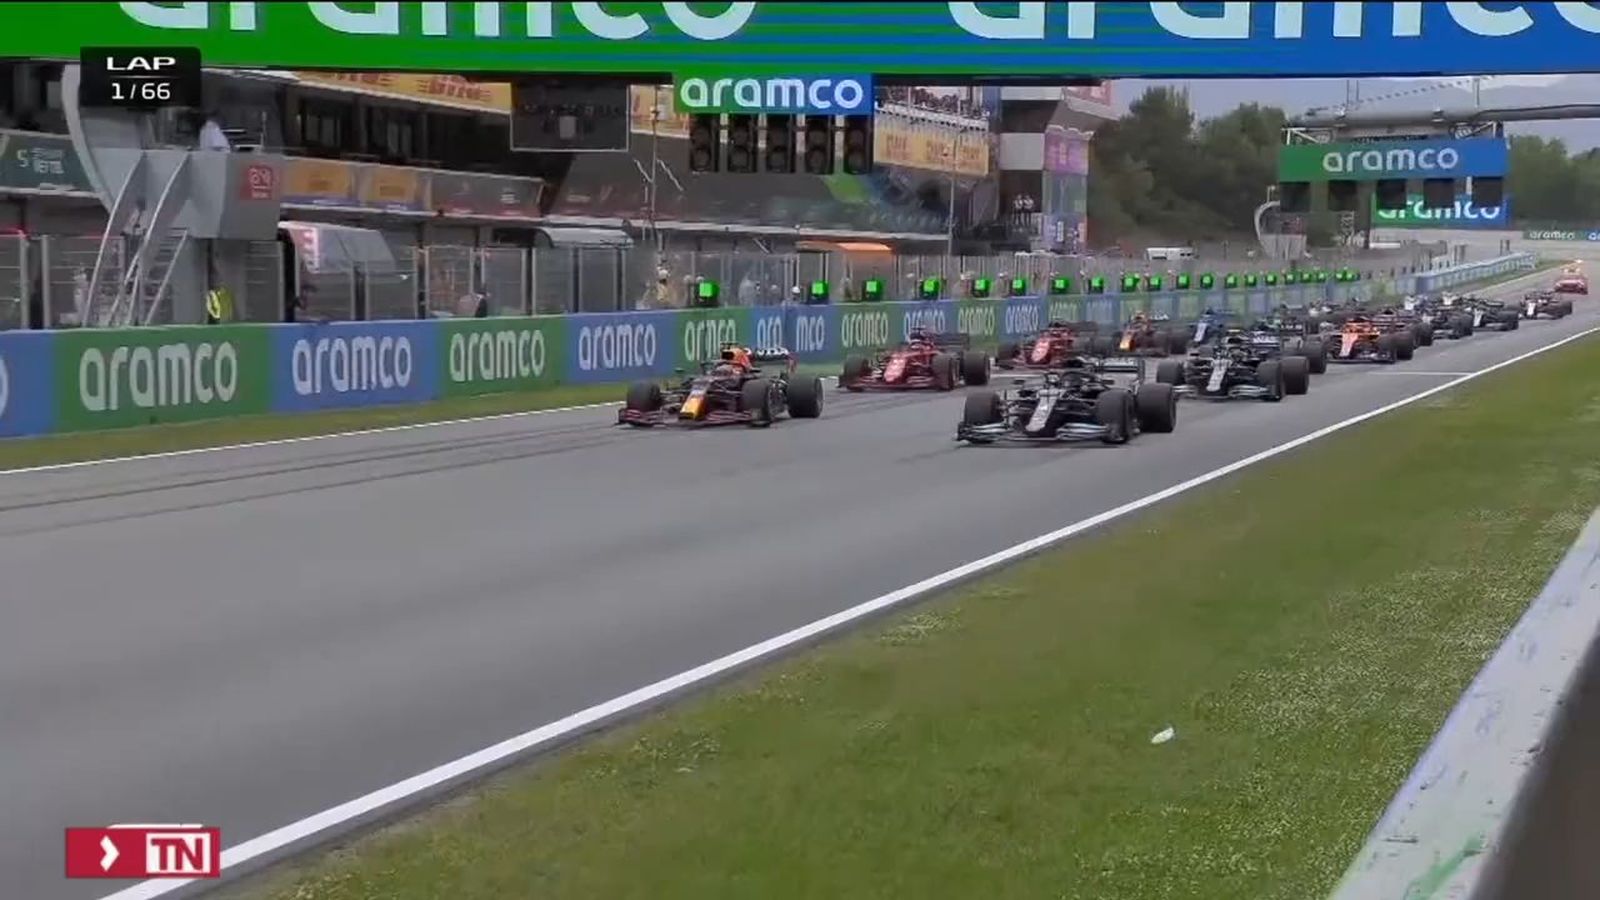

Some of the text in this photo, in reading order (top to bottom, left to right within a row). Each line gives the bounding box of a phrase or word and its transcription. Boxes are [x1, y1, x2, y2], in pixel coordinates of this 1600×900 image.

[680, 78, 863, 109] aramco
[1323, 147, 1458, 172] aramco
[841, 310, 889, 347] aramco
[1006, 303, 1039, 333] aramco
[292, 335, 411, 395] aramco
[449, 329, 545, 382] aramco
[578, 323, 656, 370] aramco
[79, 341, 237, 411] aramco
